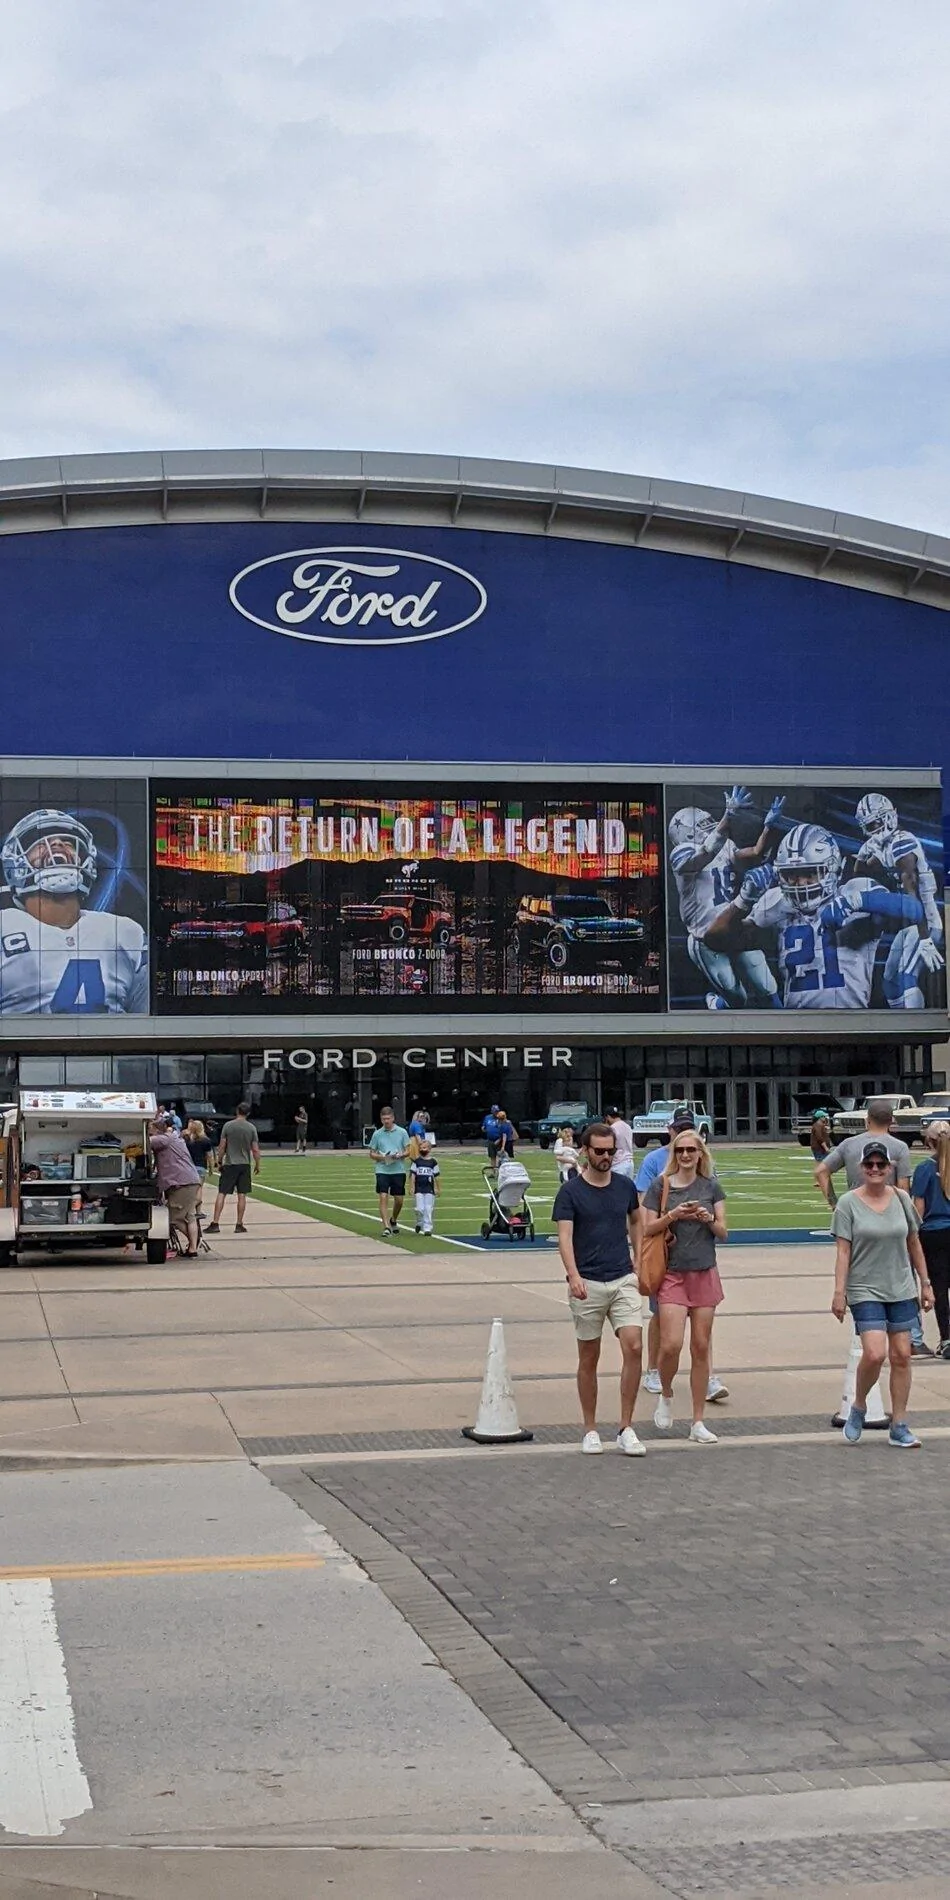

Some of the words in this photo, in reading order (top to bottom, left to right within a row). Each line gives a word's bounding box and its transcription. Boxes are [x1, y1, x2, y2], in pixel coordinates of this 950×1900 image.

[276, 559, 442, 627] Ford
[190, 815, 241, 852] THE
[256, 815, 379, 853] RETURN
[394, 817, 434, 853] OF
[450, 817, 469, 853] A
[483, 818, 625, 854] LEGEND
[3, 934, 27, 951] C
[352, 948, 371, 960] FORD
[374, 948, 415, 960] BRONCO
[783, 925, 845, 992] 21
[50, 958, 110, 1014] 4
[173, 970, 193, 981] FORD
[196, 970, 239, 981] BRONCO
[241, 970, 264, 981] SPORT
[541, 975, 560, 986] FORD
[563, 975, 603, 986] BRONCO
[263, 1048, 377, 1069] FORD
[402, 1047, 573, 1068] CENTER
